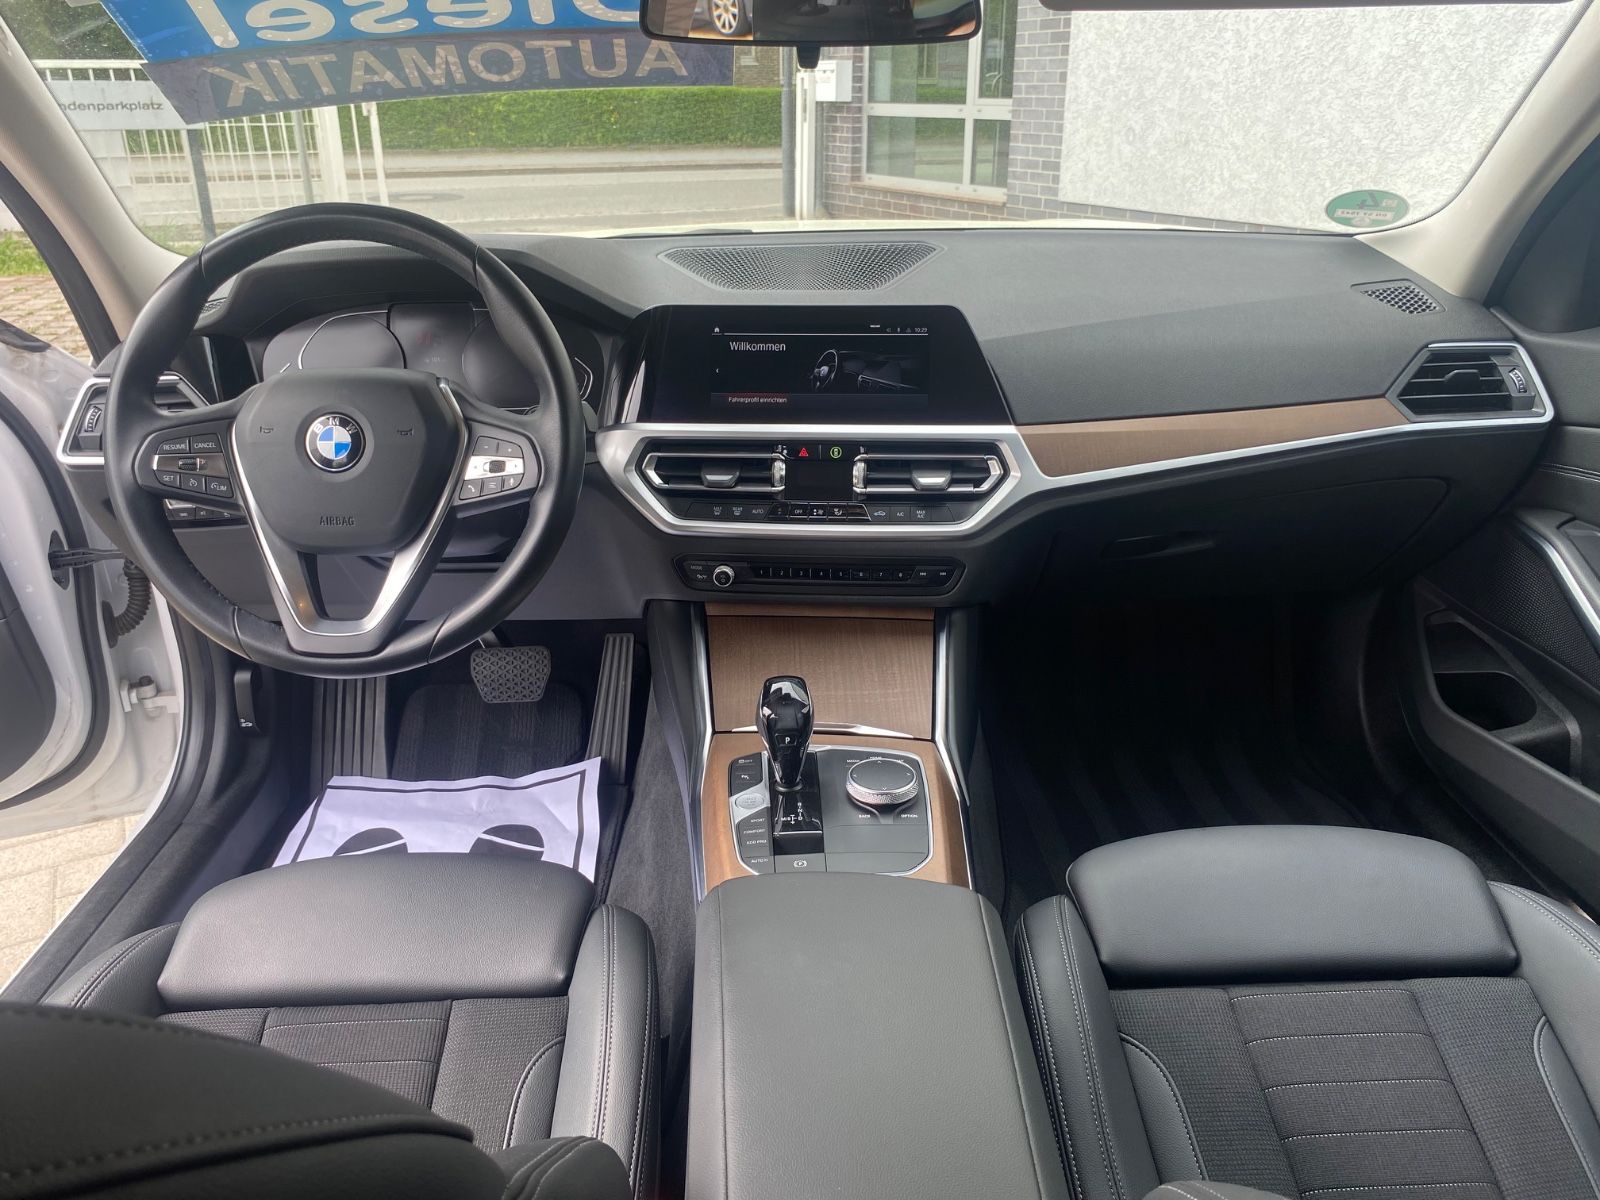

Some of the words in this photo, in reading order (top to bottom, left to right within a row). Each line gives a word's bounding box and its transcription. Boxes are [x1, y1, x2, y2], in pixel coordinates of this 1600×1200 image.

[60, 100, 164, 112] ndenparkplatz
[729, 341, 786, 351] Willkommen
[313, 416, 358, 435] BMW
[319, 516, 355, 526] AIRBAG
[785, 736, 790, 744] P
